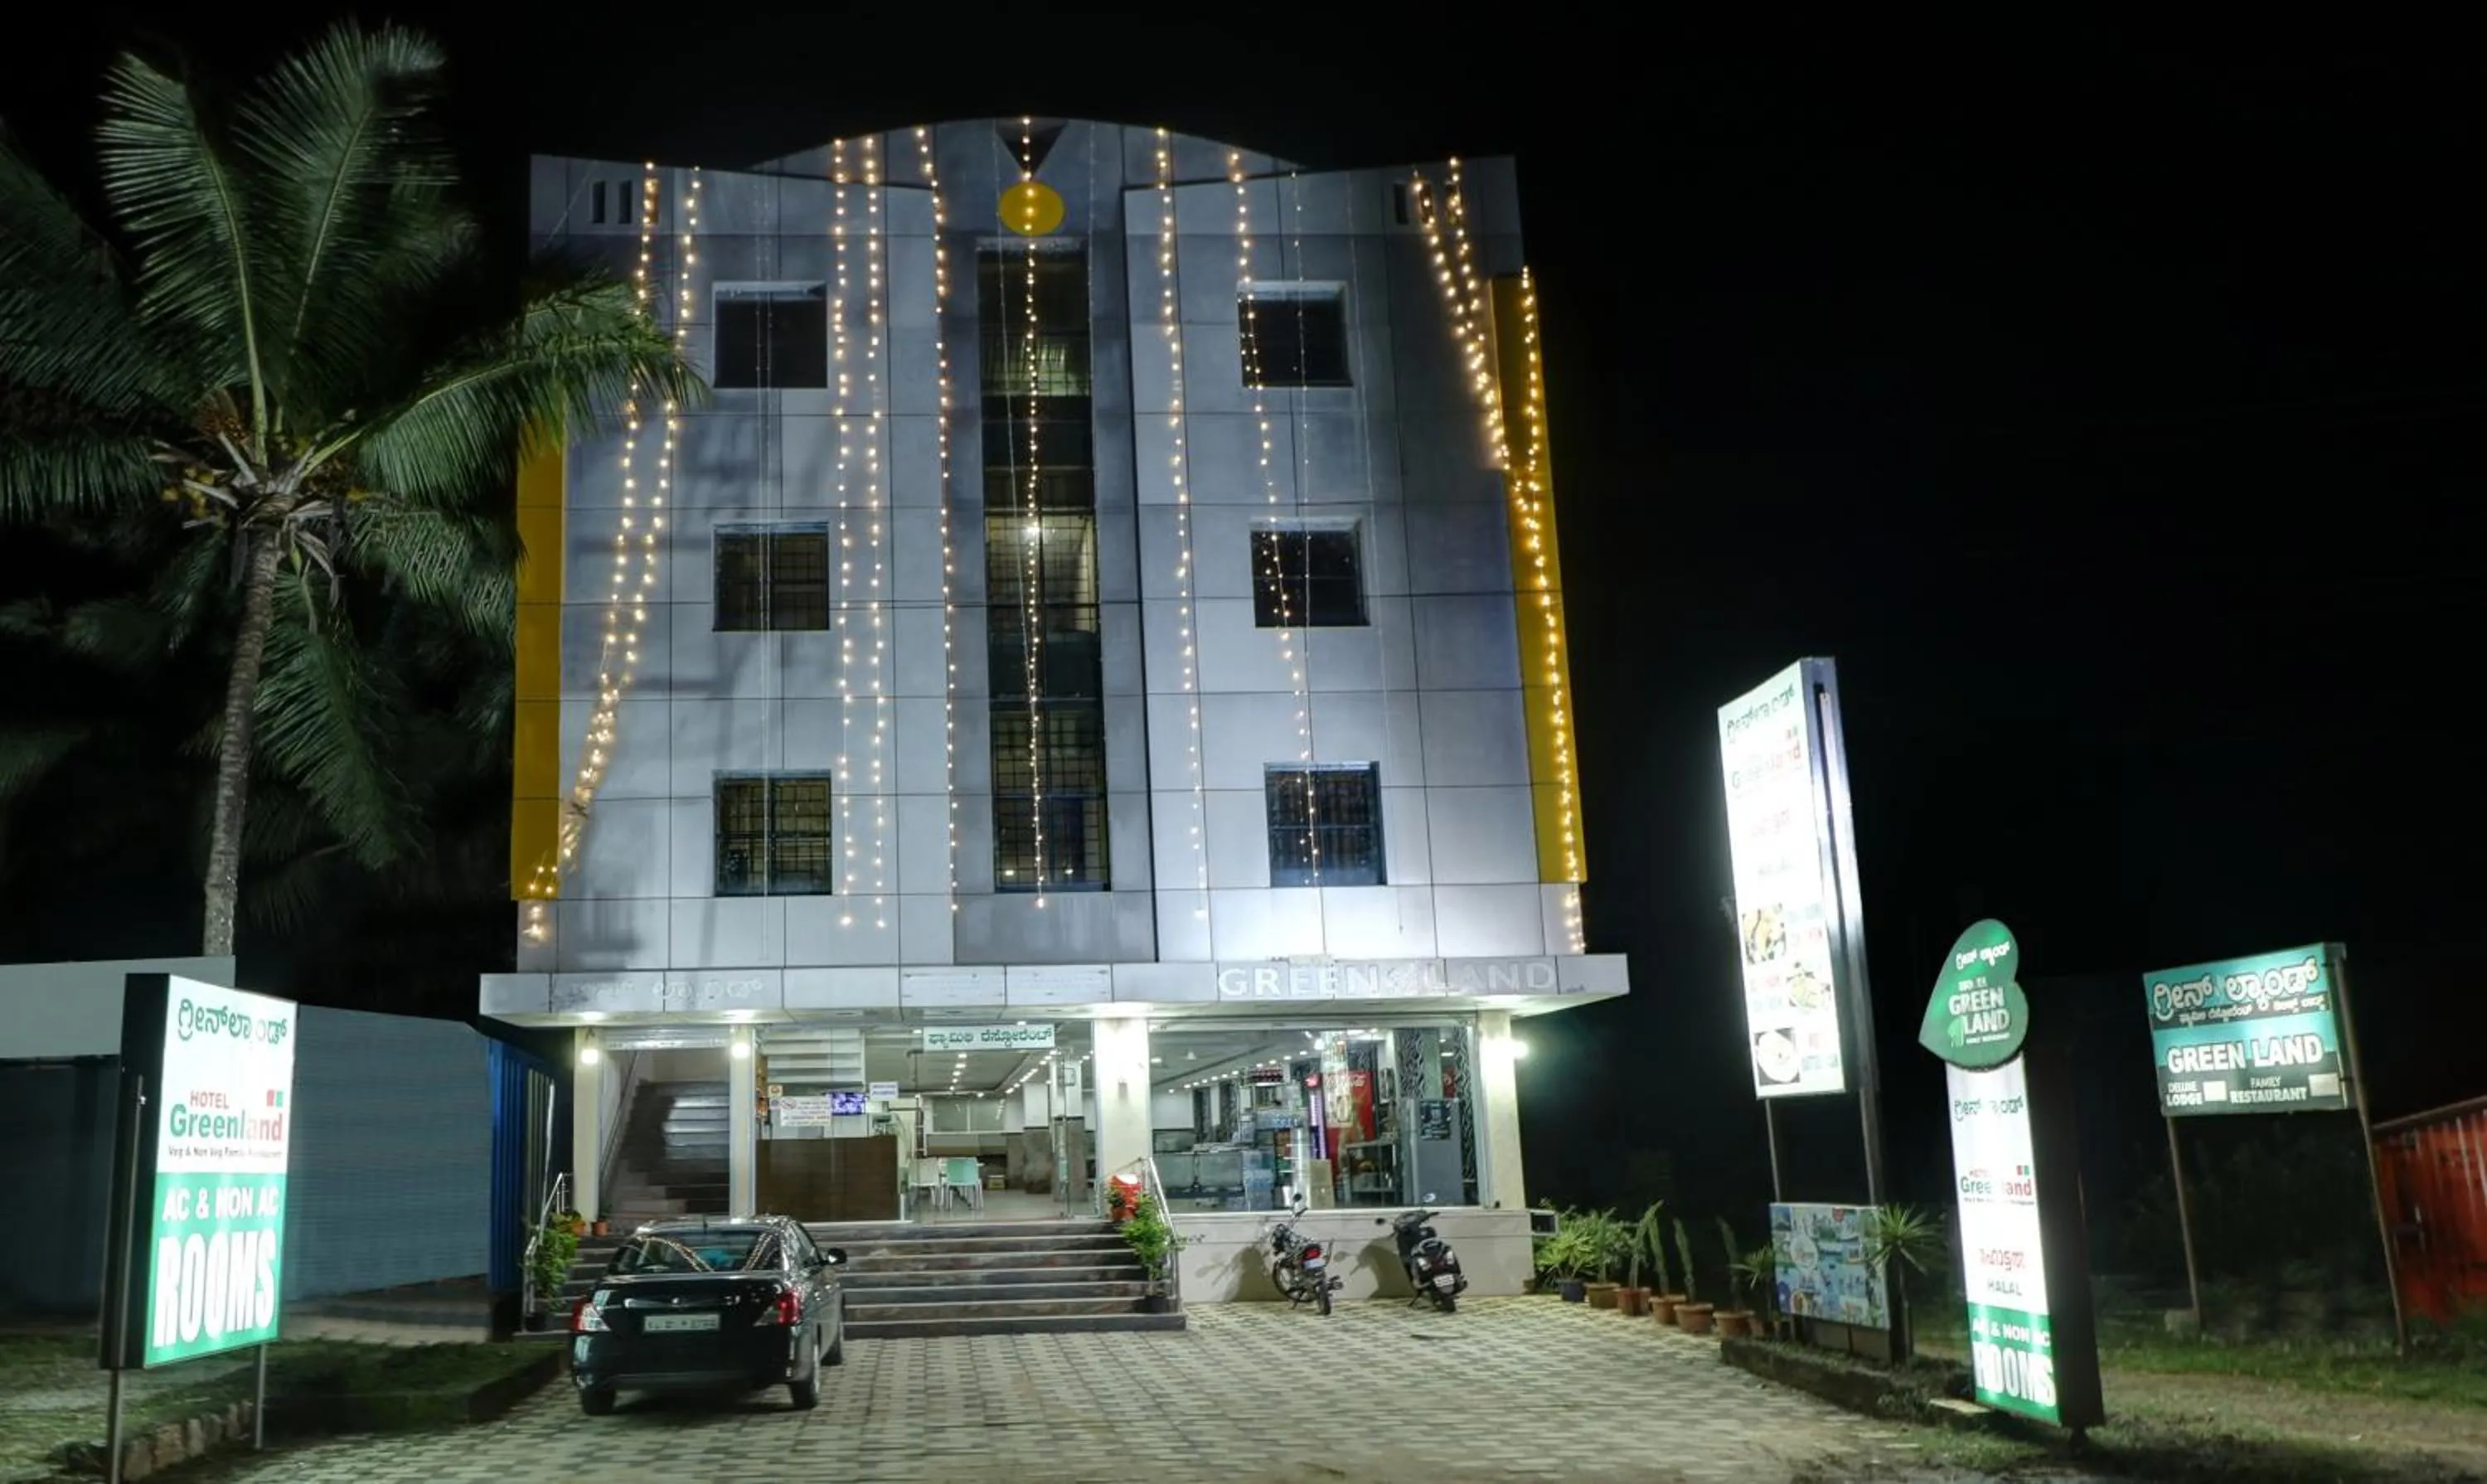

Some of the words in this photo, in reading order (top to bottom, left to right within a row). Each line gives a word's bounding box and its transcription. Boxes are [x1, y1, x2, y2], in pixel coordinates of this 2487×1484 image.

[1219, 965, 1379, 996] GREEN
[1949, 987, 2005, 1016] GREEN
[1964, 1008, 2010, 1035] LAND
[2167, 1041, 2247, 1074] GREEN
[2252, 1034, 2324, 1067] LAND
[190, 1089, 230, 1109] HOTEL
[2229, 1088, 2307, 1103] RESTAURANT
[170, 1103, 283, 1142] Greenland
[162, 1186, 191, 1222] AC
[196, 1187, 209, 1219] &
[216, 1186, 254, 1219] NON
[258, 1183, 280, 1218] AC
[153, 1227, 277, 1347] ROOMS
[1987, 1278, 2023, 1297] HALAL
[1972, 1341, 2057, 1407] ROOMS
